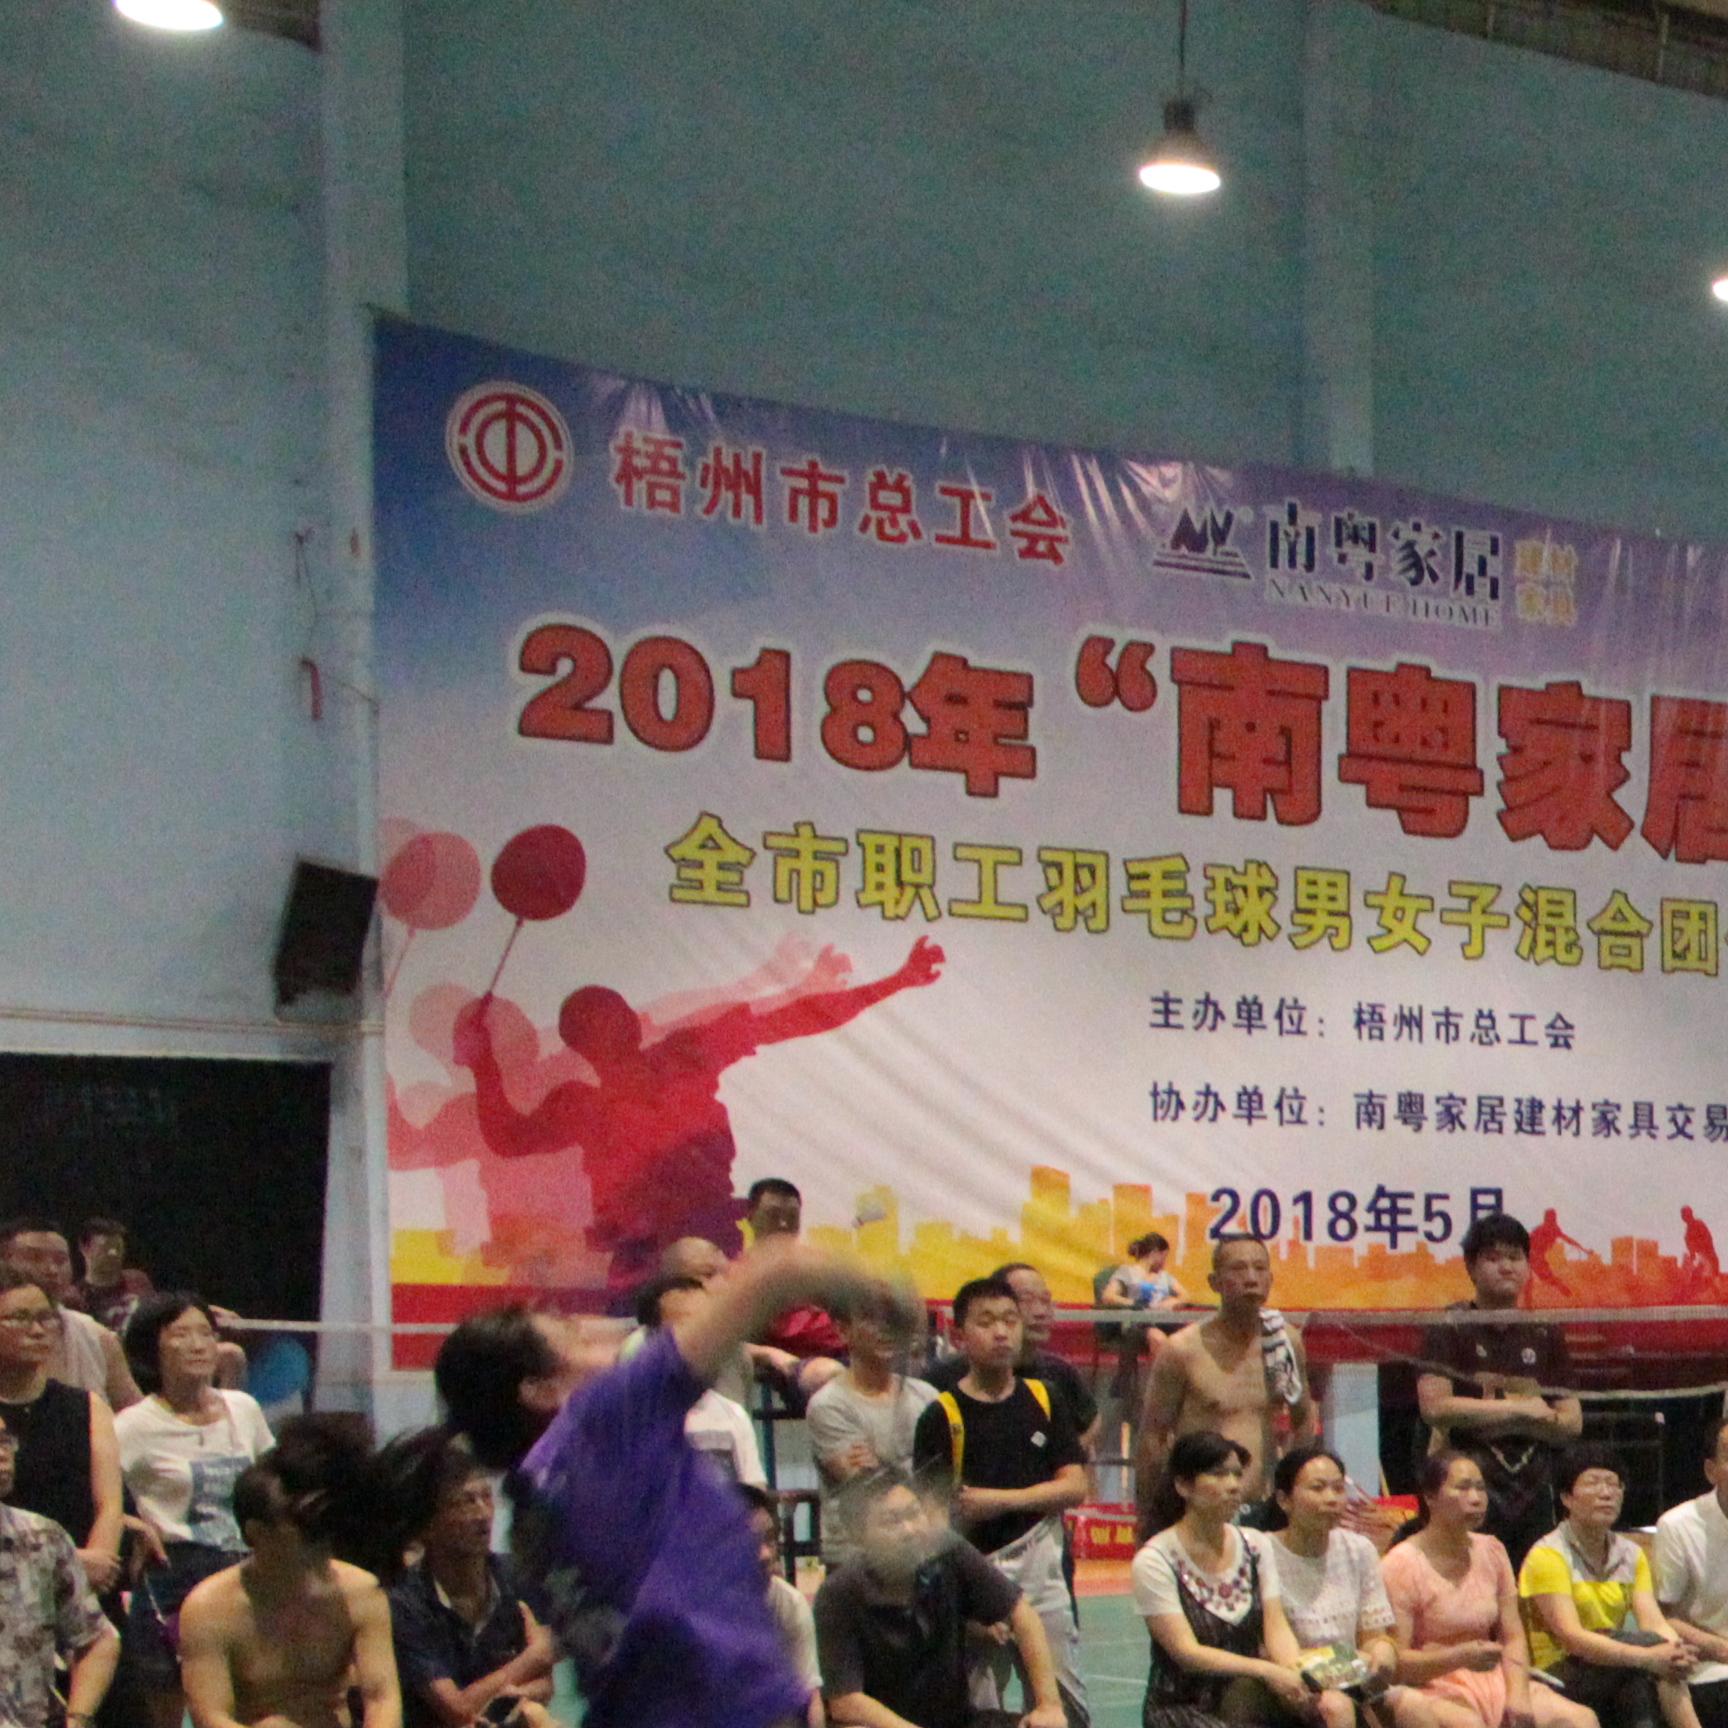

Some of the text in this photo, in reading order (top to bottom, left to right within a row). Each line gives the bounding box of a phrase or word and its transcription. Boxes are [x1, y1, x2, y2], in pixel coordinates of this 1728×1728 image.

[610, 428, 1072, 566] 梧州市总工会
[1268, 500, 1500, 600] 南粤家居
[1410, 598, 1499, 627] HOME
